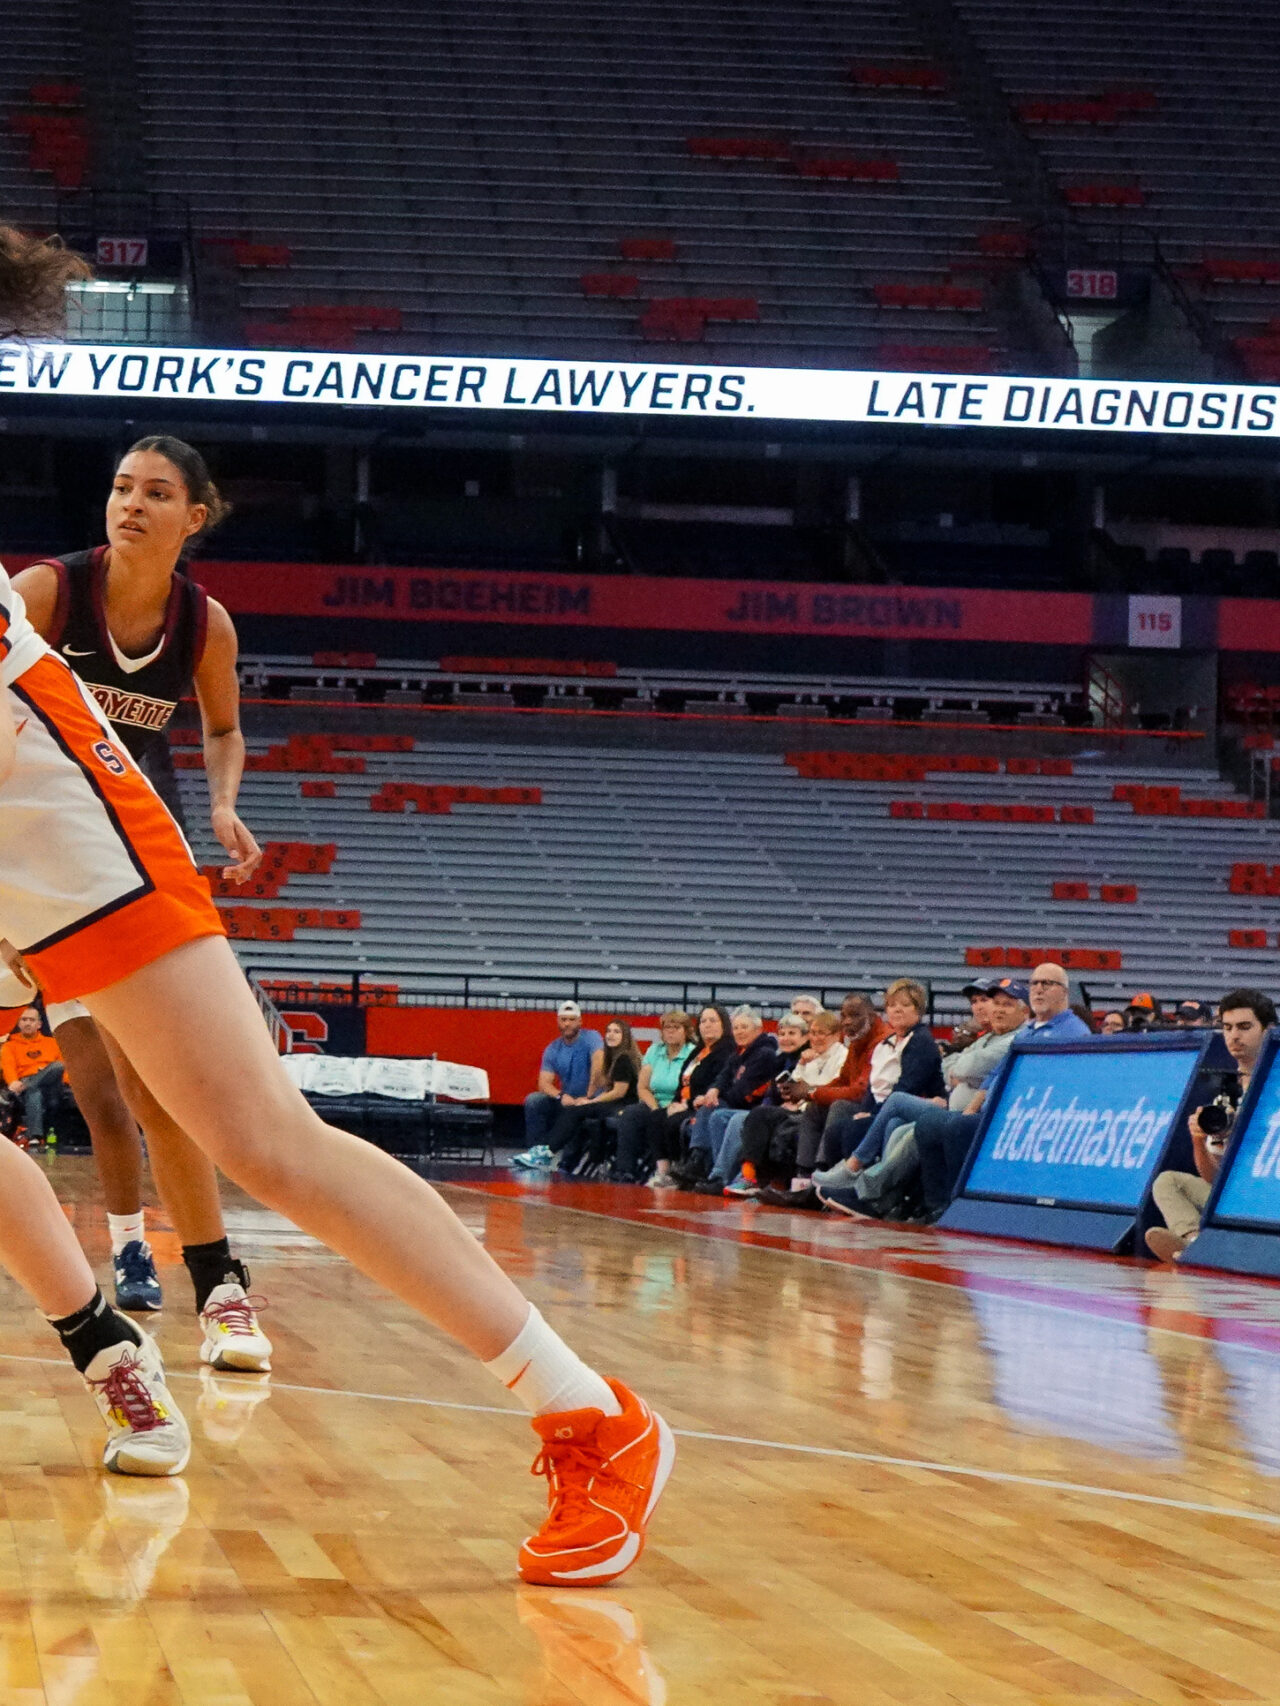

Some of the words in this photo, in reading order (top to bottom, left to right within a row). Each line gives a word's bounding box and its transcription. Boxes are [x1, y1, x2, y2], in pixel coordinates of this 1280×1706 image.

[99, 241, 145, 264] 317
[1069, 273, 1115, 296] 318
[89, 353, 266, 395] YORK'S
[281, 359, 487, 403] CANCER
[503, 366, 756, 412] LAWYERS.
[866, 380, 989, 420] LATE
[1003, 385, 1278, 431] DIAGNOSIS
[323, 577, 394, 607] JIM
[409, 578, 591, 615] BOEHEIM
[727, 591, 797, 622] JIM
[813, 594, 963, 629] BROWN
[1138, 612, 1172, 631] 115
[86, 687, 176, 729] AYETTE
[992, 1085, 1172, 1169] ticketmaster
